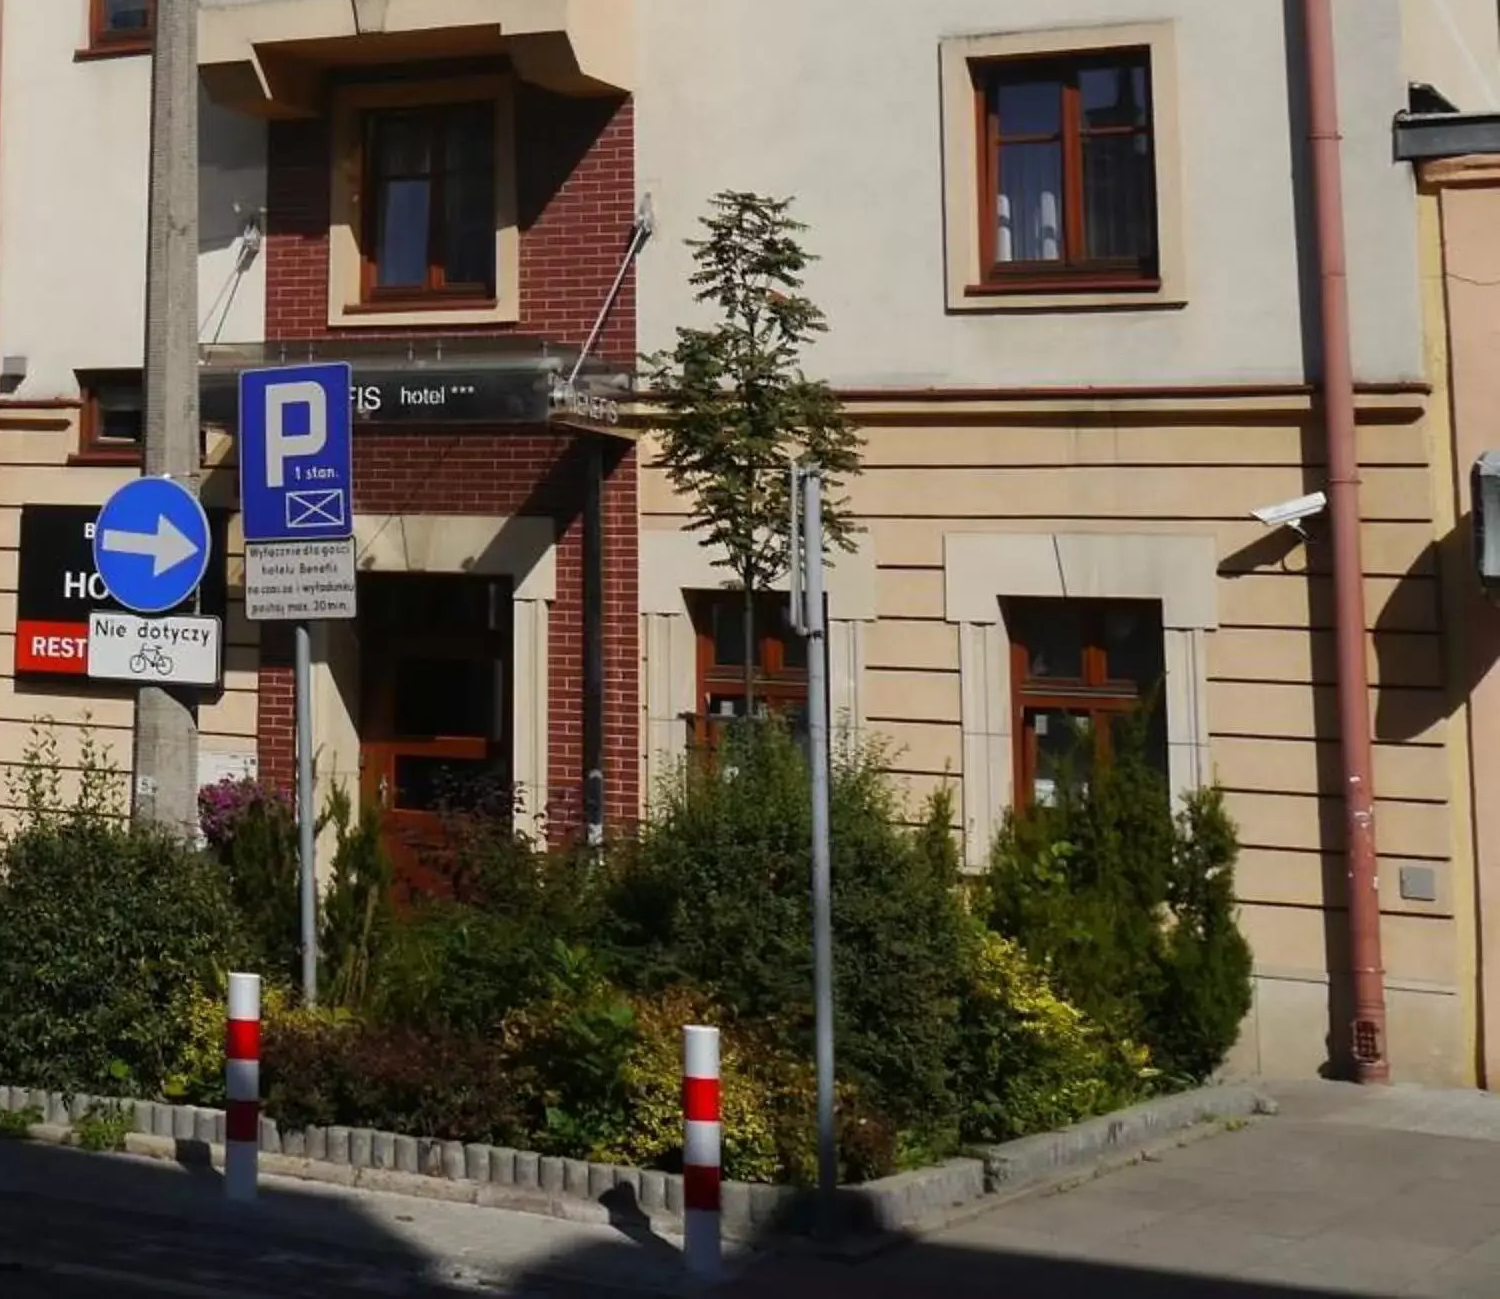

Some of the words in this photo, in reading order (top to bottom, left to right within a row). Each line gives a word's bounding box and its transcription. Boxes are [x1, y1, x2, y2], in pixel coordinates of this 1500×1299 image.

[348, 386, 381, 410] FIS
[401, 386, 445, 405] hotel
[266, 381, 326, 487] P
[295, 466, 301, 480] 1
[84, 523, 95, 539] B
[64, 571, 110, 600] HO
[95, 621, 128, 638] Nie
[137, 622, 211, 646] dotyczy
[31, 636, 87, 659] REST
